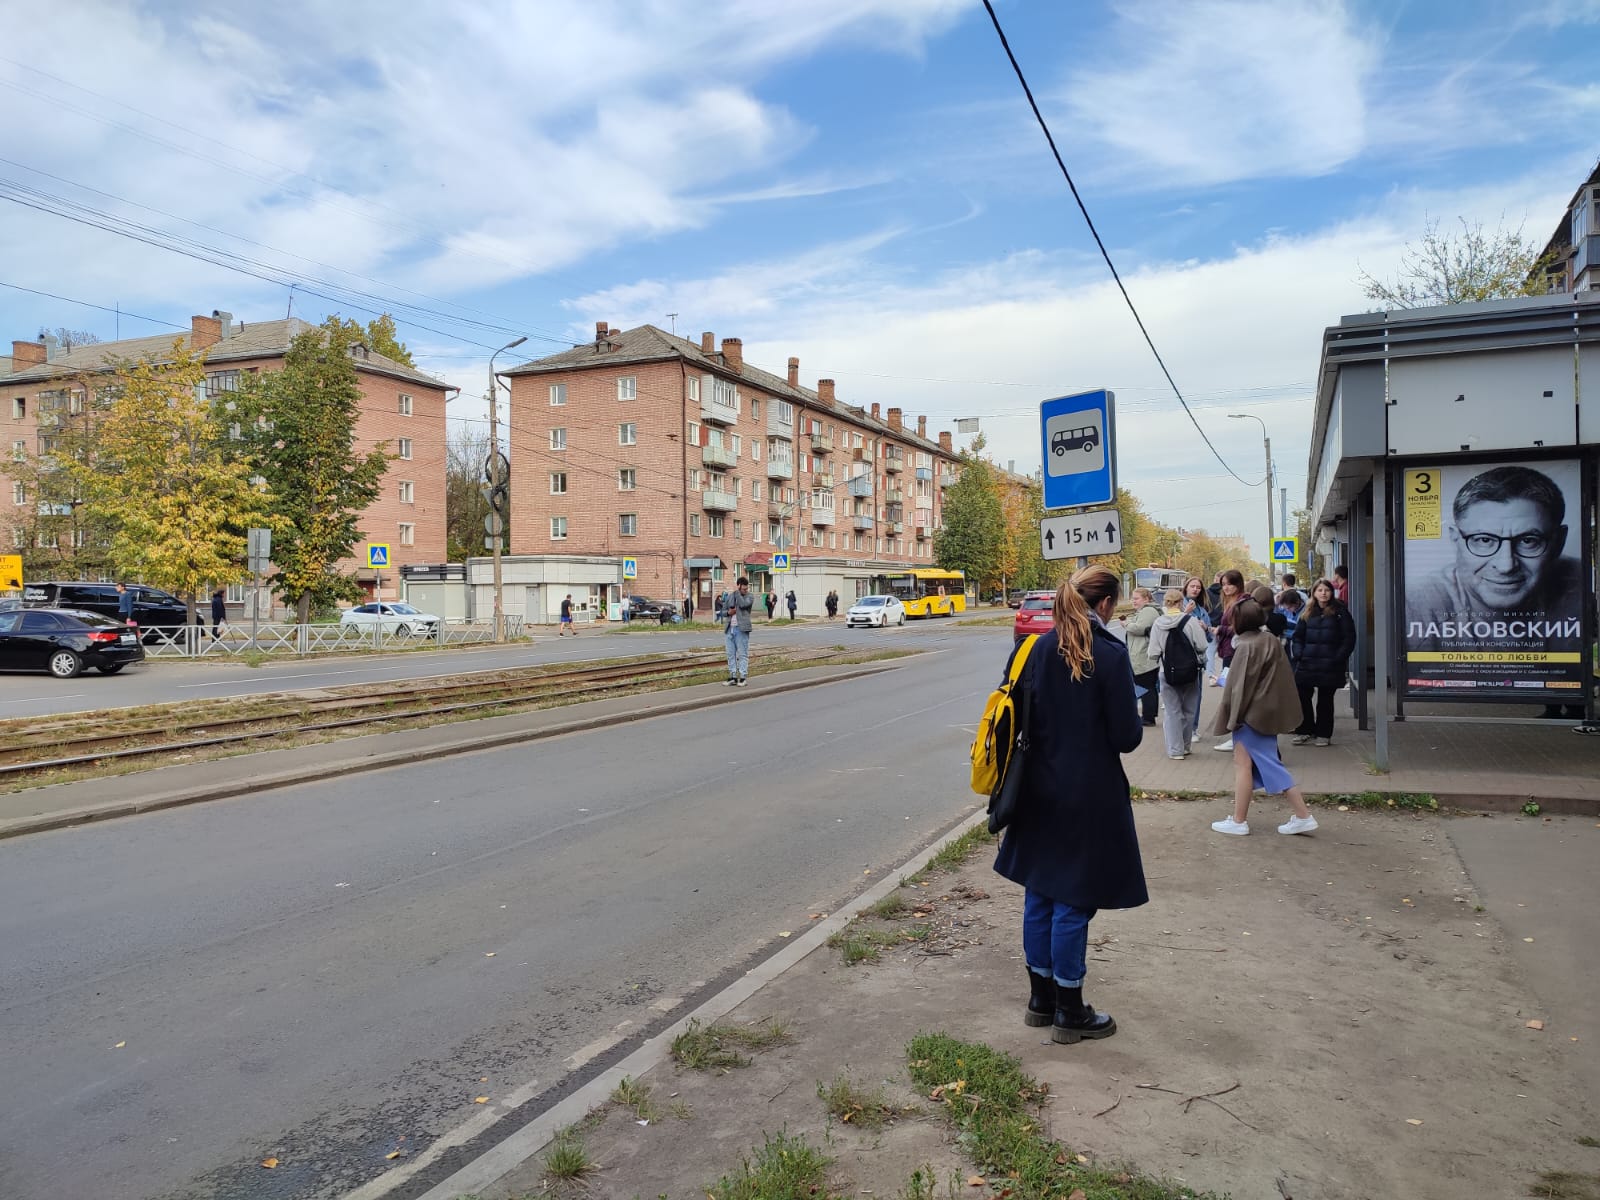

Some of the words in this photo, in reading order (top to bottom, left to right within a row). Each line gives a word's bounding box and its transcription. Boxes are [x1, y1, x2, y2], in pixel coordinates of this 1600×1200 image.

[1415, 472, 1432, 494] 3
[1064, 528, 1083, 545] 15
[1406, 617, 1581, 638] ЛАБКОВСКИЙ
